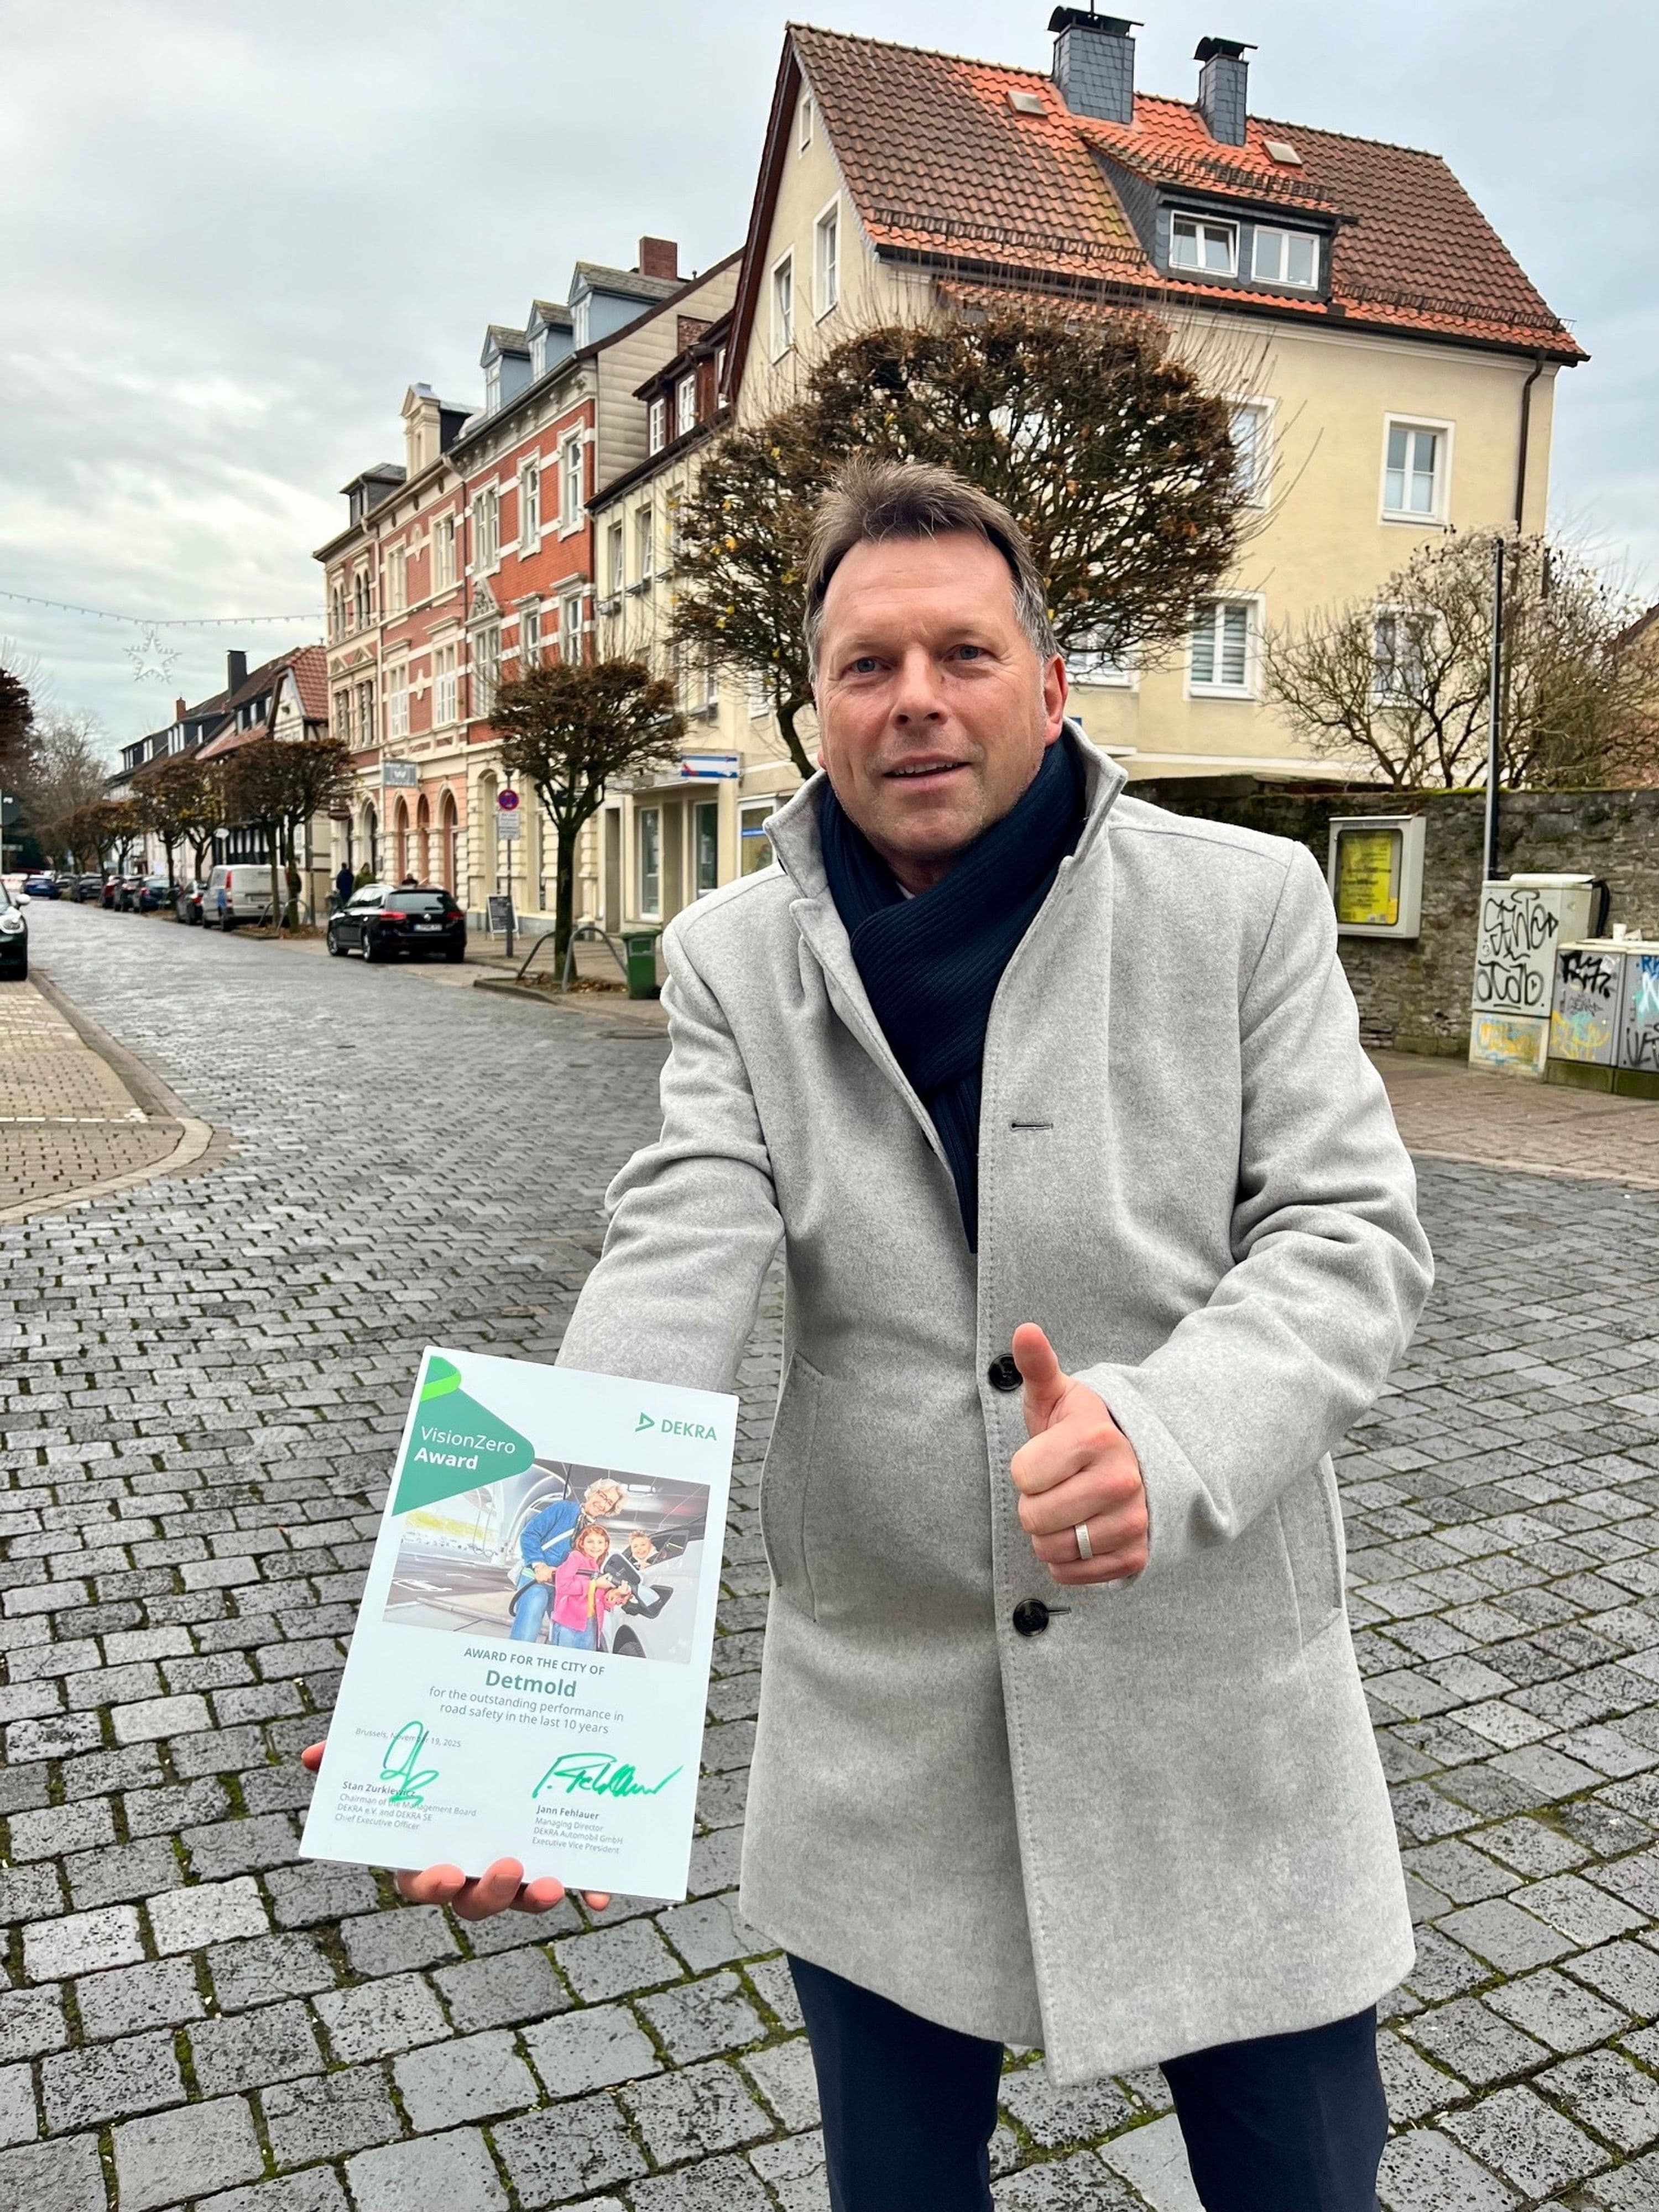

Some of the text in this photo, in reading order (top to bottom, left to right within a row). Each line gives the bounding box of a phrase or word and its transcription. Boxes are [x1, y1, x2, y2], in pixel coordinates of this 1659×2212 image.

[421, 1426, 515, 1454] VisionZero
[661, 1419, 717, 1441] DEKRA
[414, 1447, 478, 1470] Award
[464, 1647, 606, 1676] AWARD FOR THE CITY OF
[485, 1670, 577, 1697] Detmold
[429, 1686, 624, 1722] for the outstanding performance in
[440, 1703, 609, 1734] road safety in the last 10 years
[356, 1728, 388, 1739] Brussels,
[431, 1738, 441, 1746] 19,
[444, 1739, 461, 1748] 2025
[342, 1781, 363, 1792] Stan
[337, 1803, 363, 1814] DEKRA
[379, 1808, 394, 1818] and
[396, 1809, 421, 1820] DEKRA
[423, 1813, 432, 1822] SE
[340, 1793, 377, 1804] Chairman
[378, 1798, 387, 1806] of
[454, 1807, 476, 1817] Board
[536, 1804, 599, 1820] Jann Fehlauer
[335, 1813, 420, 1830] Chief Executive Officer
[535, 1817, 603, 1832] Managing Director
[532, 1837, 620, 1854] Executive Vice President
[534, 1827, 623, 1845] DEKRA Automobil GmbH
